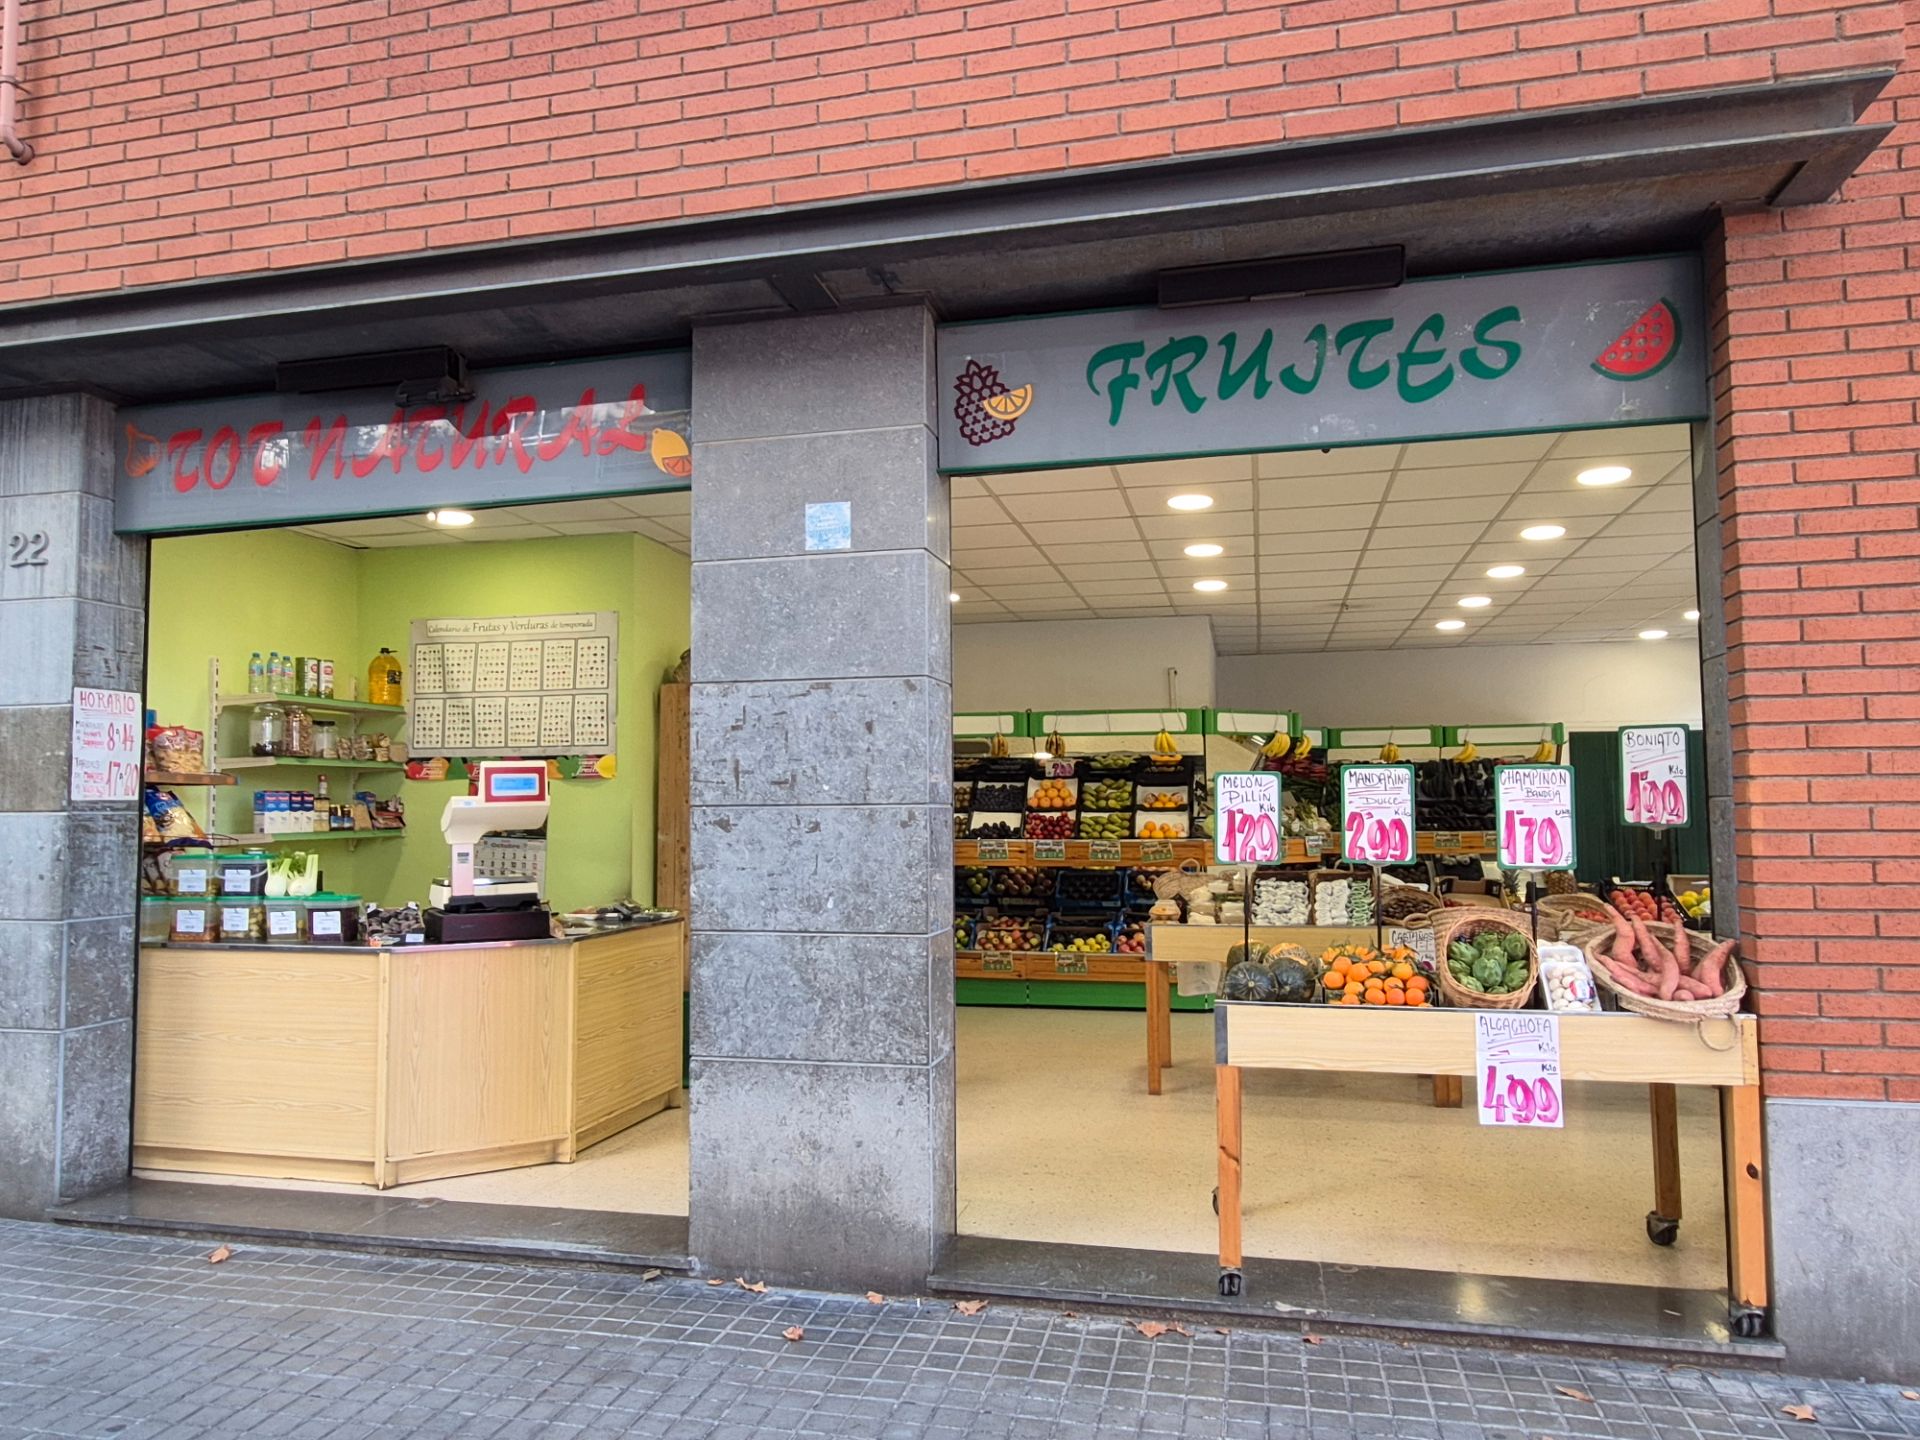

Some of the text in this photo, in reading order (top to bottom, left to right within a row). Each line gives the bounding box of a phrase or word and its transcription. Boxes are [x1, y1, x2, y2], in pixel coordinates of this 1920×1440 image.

[1086, 304, 1522, 427] FRUITES
[166, 382, 648, 493] TOT NATURAL
[9, 530, 50, 568] 22
[428, 624, 461, 634] Calendario
[473, 621, 501, 633] Frutas
[502, 623, 508, 635] y
[510, 618, 549, 631] Verduras
[80, 690, 136, 714] HORARIO
[107, 722, 116, 752] 8
[122, 723, 135, 753] 14
[1624, 730, 1681, 754] BONIATO
[106, 760, 121, 797] 17
[124, 762, 139, 797] 20
[1259, 803, 1276, 813] Kilo
[1479, 1015, 1552, 1042] ALCACHOFA
